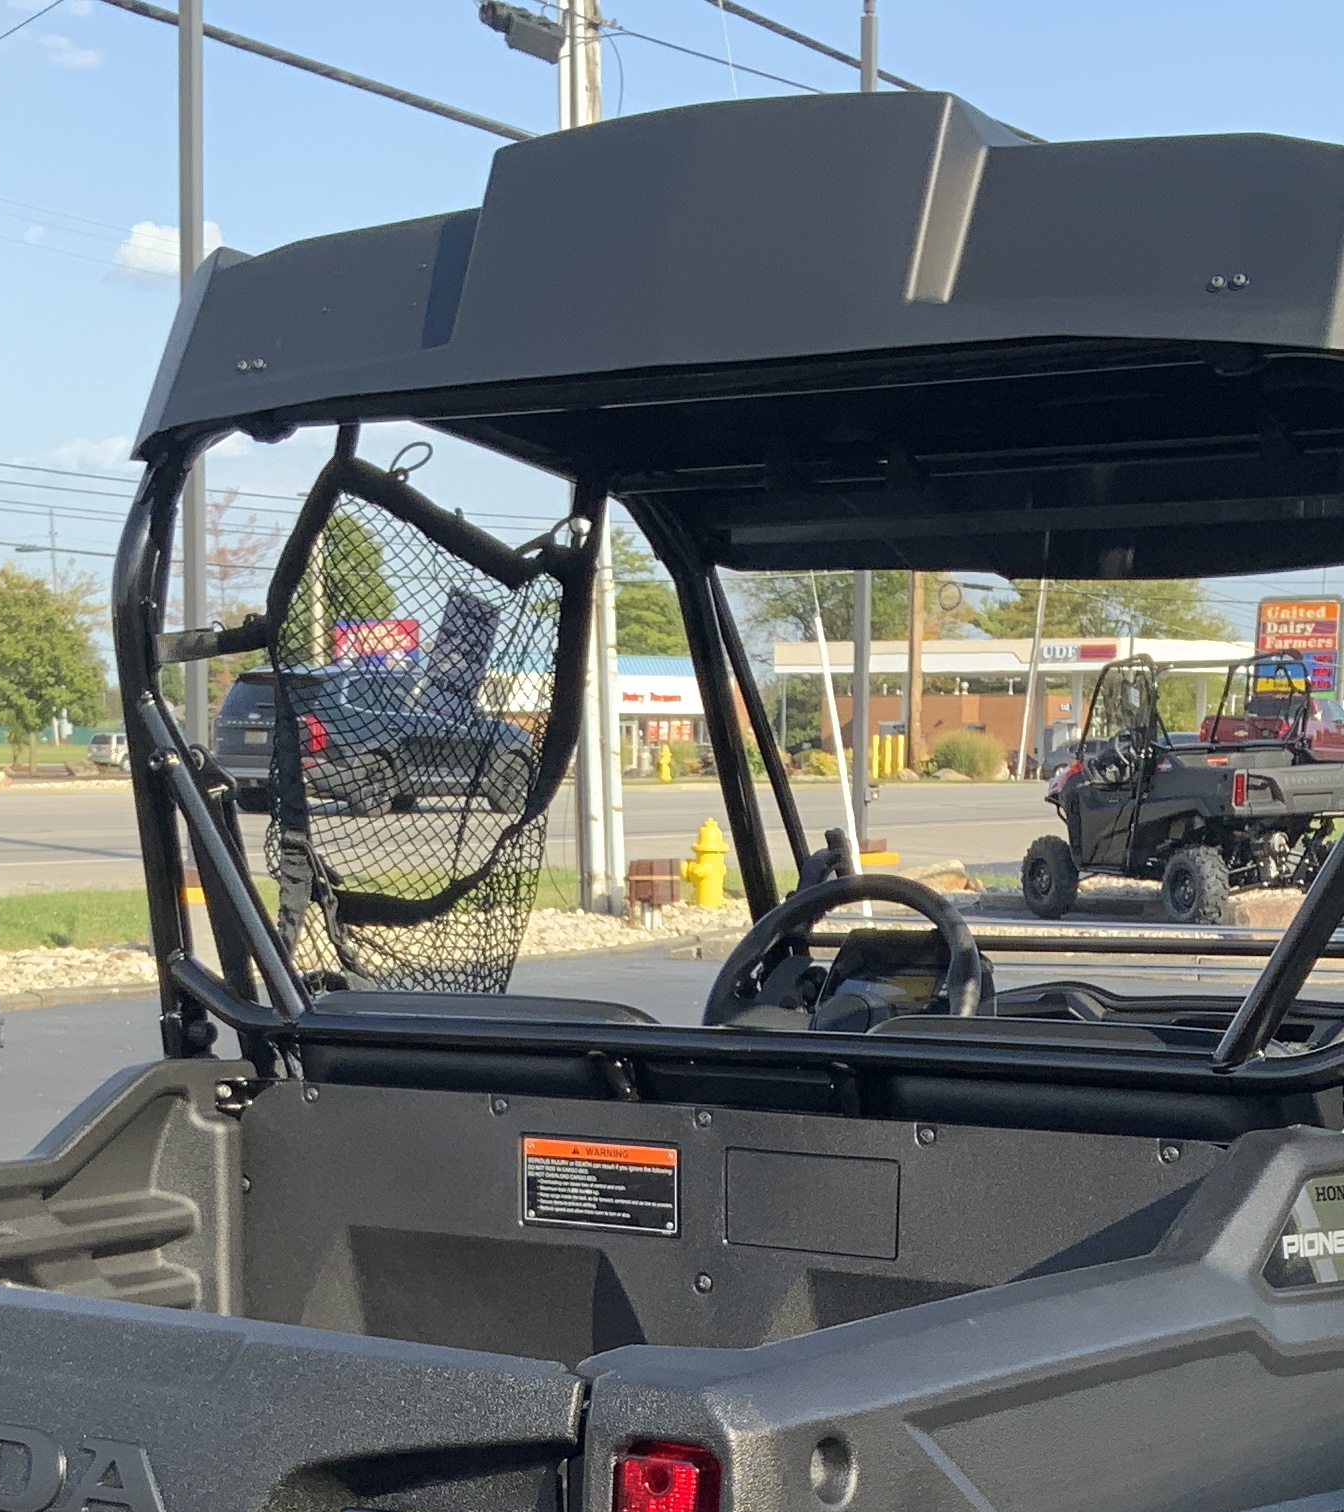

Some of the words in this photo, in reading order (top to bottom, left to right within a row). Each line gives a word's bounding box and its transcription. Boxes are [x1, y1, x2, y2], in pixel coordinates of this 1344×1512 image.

[1266, 605, 1326, 619] United
[1266, 621, 1316, 635] Dairy
[1265, 636, 1334, 649] Farmers
[1043, 645, 1078, 659] UDF
[585, 1147, 630, 1159] WARNING
